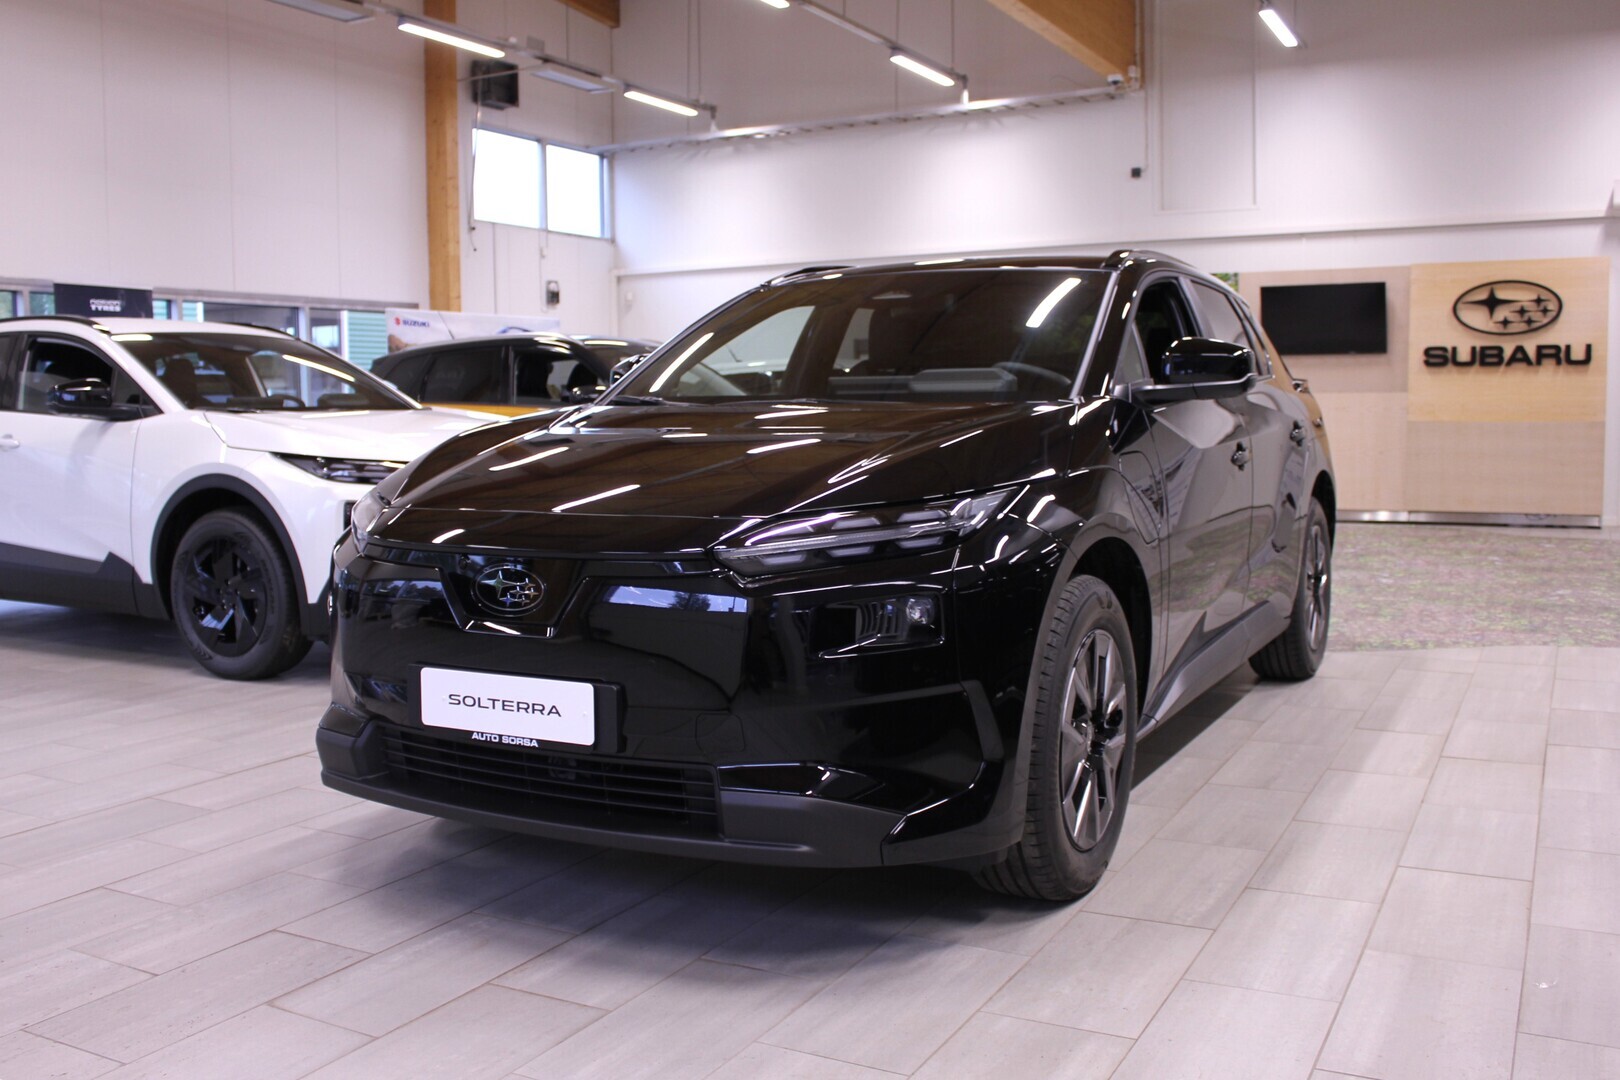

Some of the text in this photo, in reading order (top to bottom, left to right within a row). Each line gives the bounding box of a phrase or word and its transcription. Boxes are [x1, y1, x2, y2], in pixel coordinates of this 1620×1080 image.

[402, 319, 430, 328] SUZUKI
[1423, 343, 1592, 367] SUBARU
[448, 693, 562, 717] SOLTERRA
[471, 731, 539, 748] AUTO SORSA
